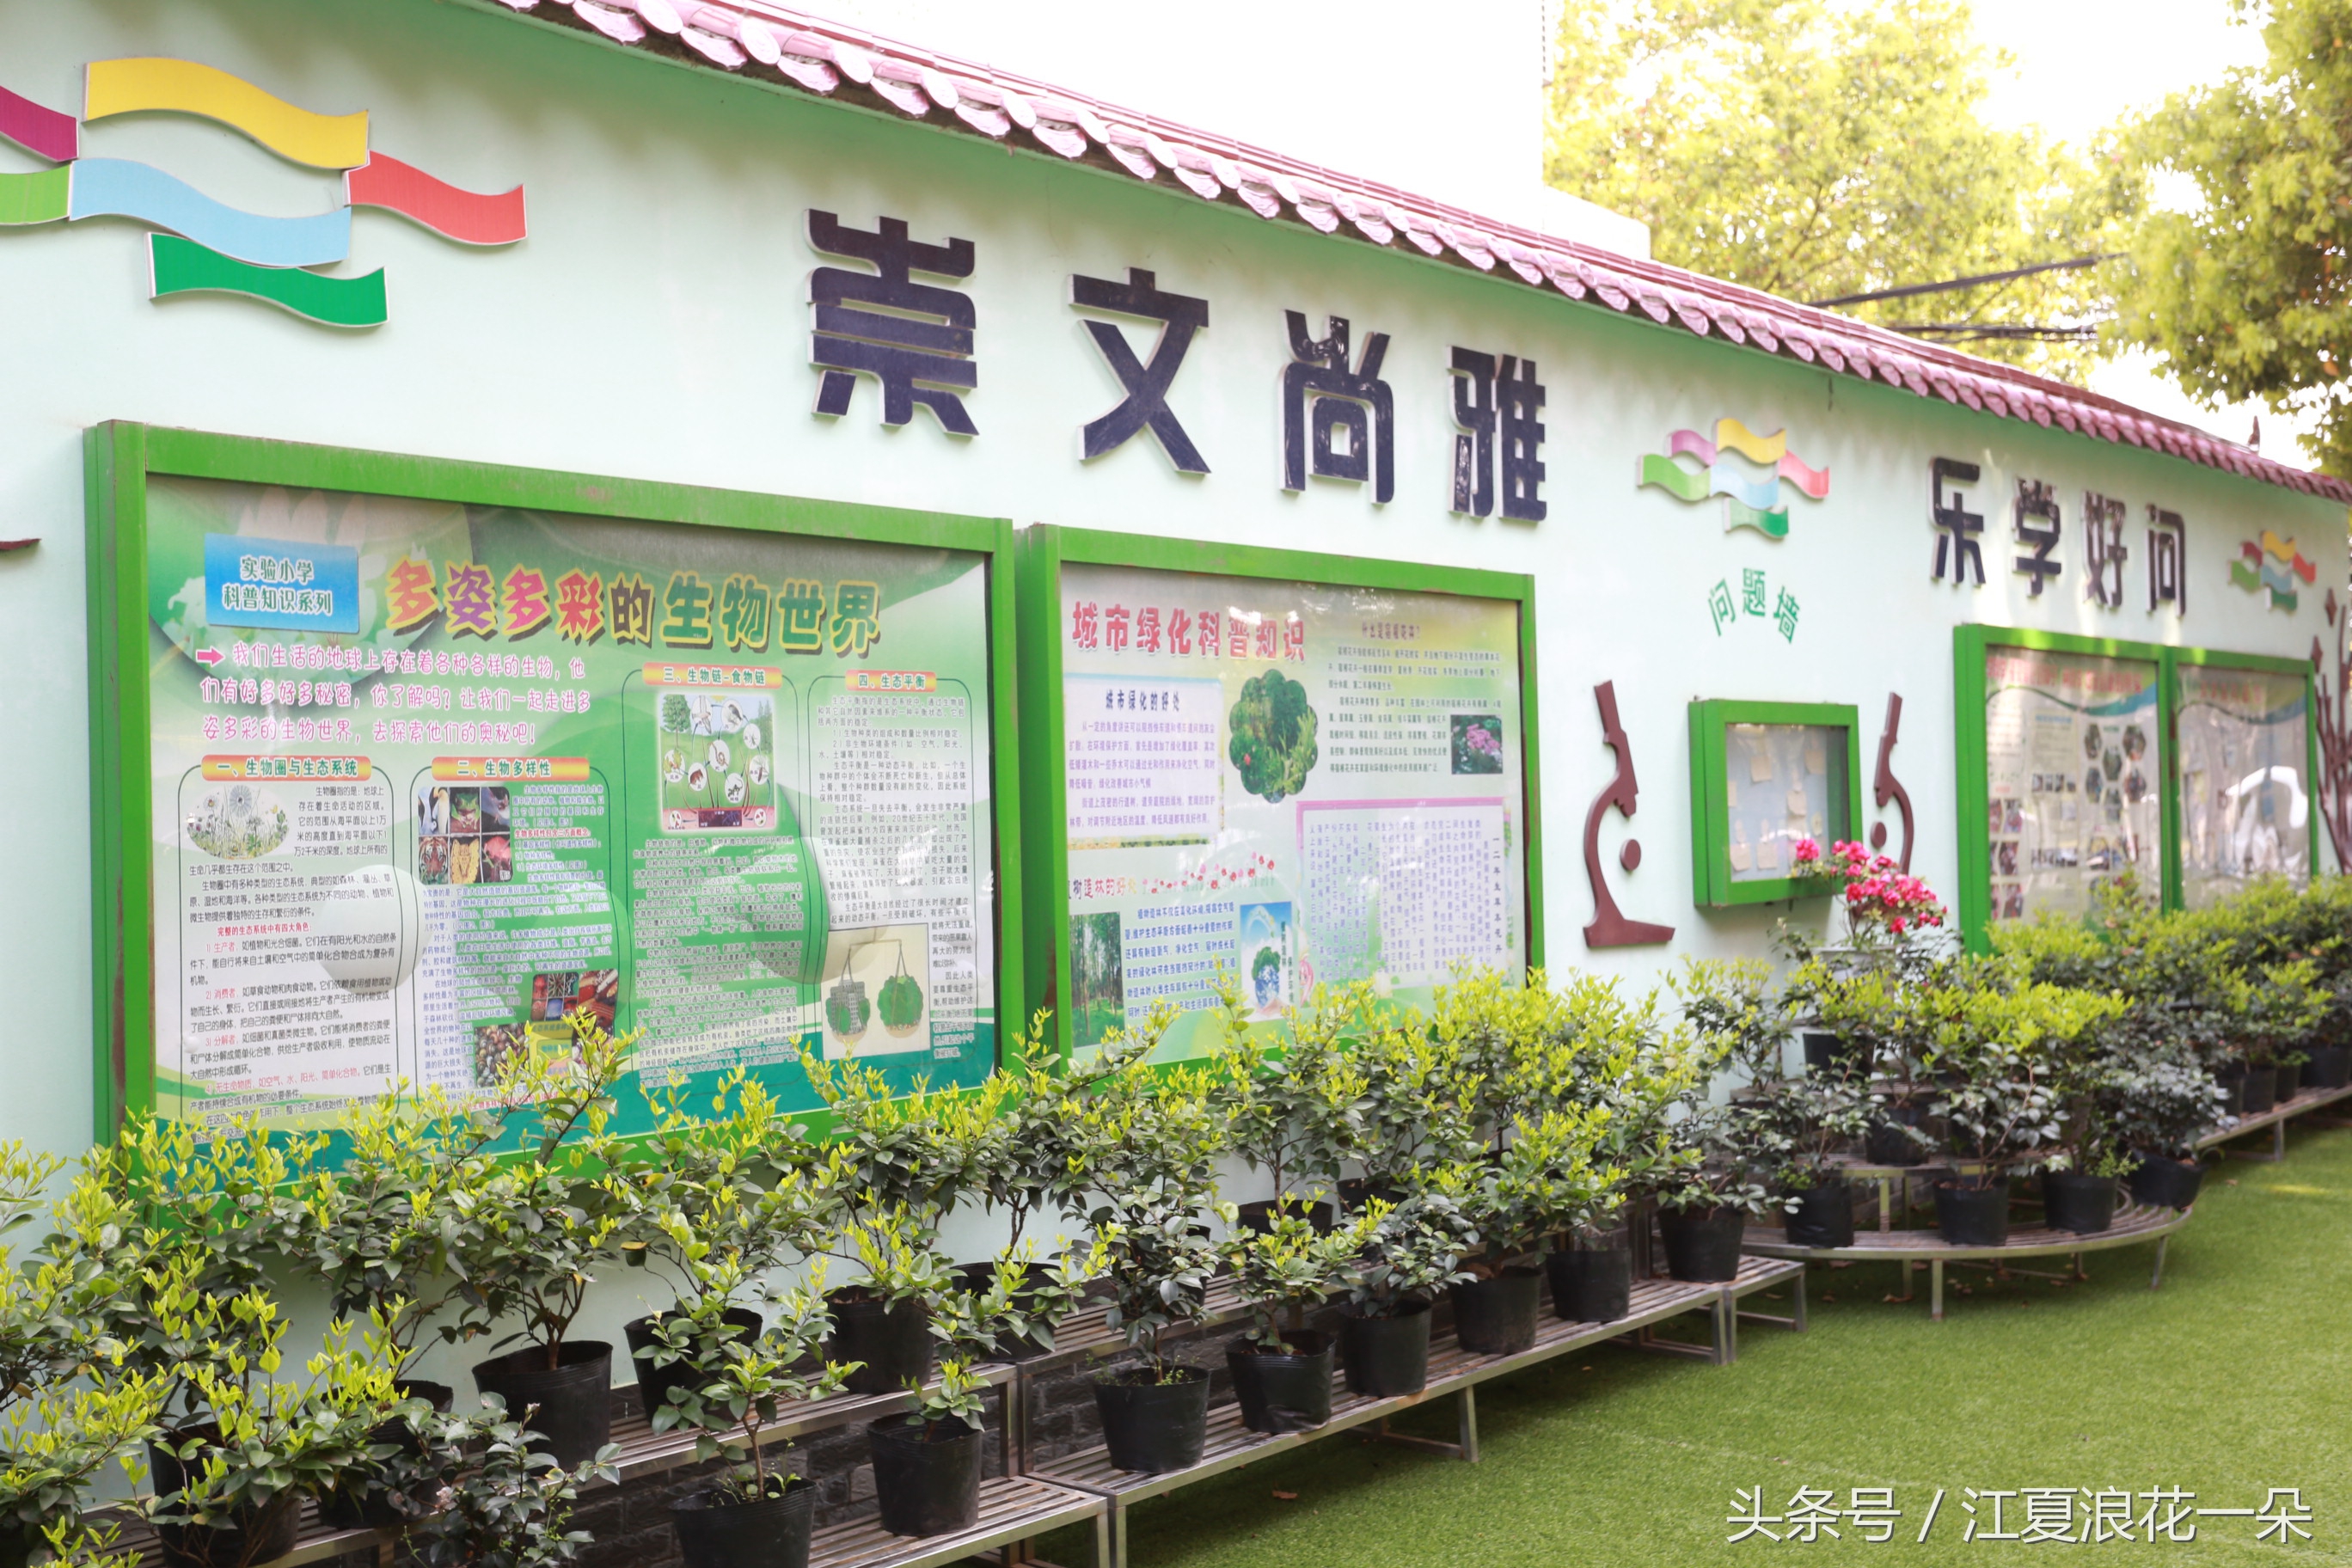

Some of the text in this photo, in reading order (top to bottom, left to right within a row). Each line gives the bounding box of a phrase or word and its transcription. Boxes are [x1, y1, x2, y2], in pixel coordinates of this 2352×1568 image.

[803, 207, 1547, 524] 崇文尚雅
[1930, 456, 2187, 617] 乐学好问
[241, 554, 314, 585] 实验小学
[222, 585, 333, 616] 科普知识系列
[385, 554, 882, 656] 多姿多彩的生物世界
[1708, 567, 1800, 644] 问题墙
[1073, 601, 1304, 661] 城市绿化科普知识
[233, 641, 585, 680] 我们生活的地球上存在着各种各样的生物，他
[859, 674, 925, 688] 四、生态平衡
[1106, 689, 1179, 712] 城市绿化的好处
[217, 757, 358, 777] 一、生物圈与生态系统
[457, 760, 551, 776] 二、生物多样性
[297, 830, 387, 842] 米的高度直到海平面以下1
[298, 816, 387, 826] 它的范围从海平面以上1万
[1069, 878, 1136, 899] 树造林的好处
